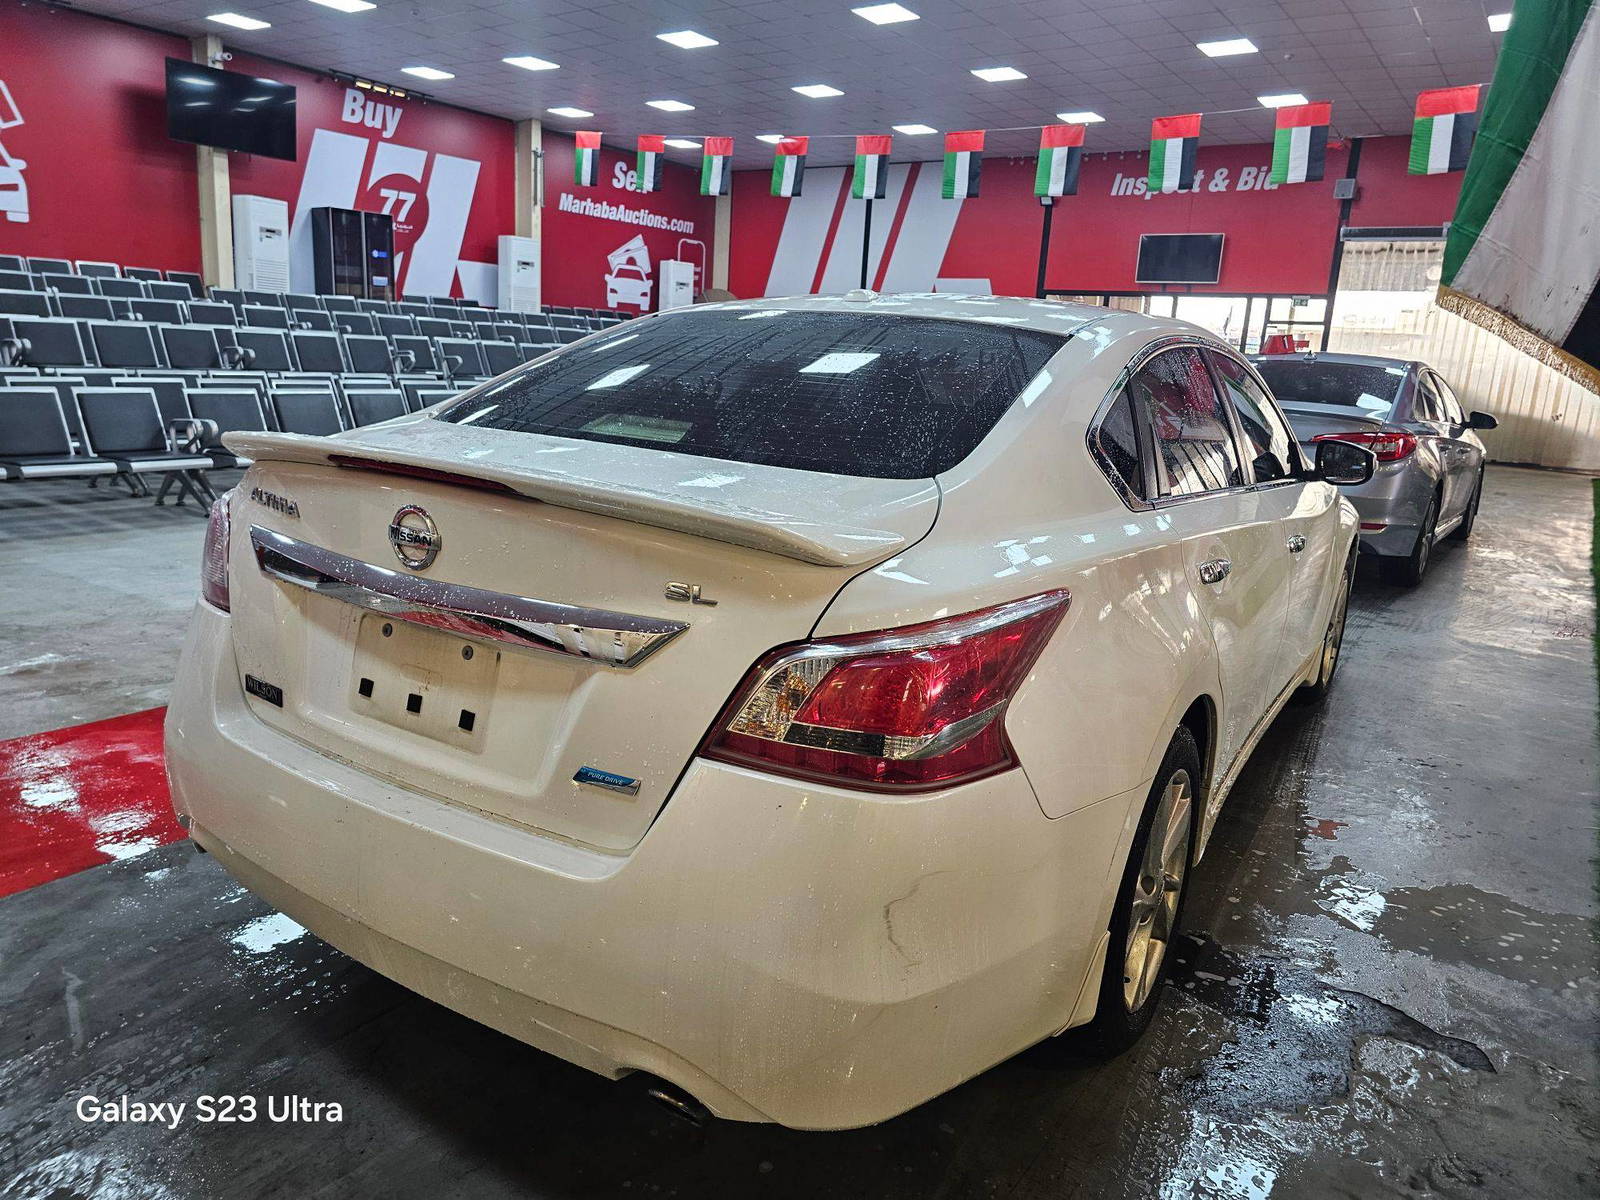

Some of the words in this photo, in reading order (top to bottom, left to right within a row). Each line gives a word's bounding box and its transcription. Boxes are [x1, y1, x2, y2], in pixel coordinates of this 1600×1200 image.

[341, 87, 403, 138] Buy
[612, 161, 655, 194] Se
[1208, 167, 1230, 192] &
[379, 188, 417, 222] 77
[558, 192, 695, 234] MarhabaAuctions.com
[390, 527, 432, 547] NISSAN
[664, 580, 719, 607] SL
[587, 771, 605, 780] PURE
[604, 775, 625, 785] DRIVE
